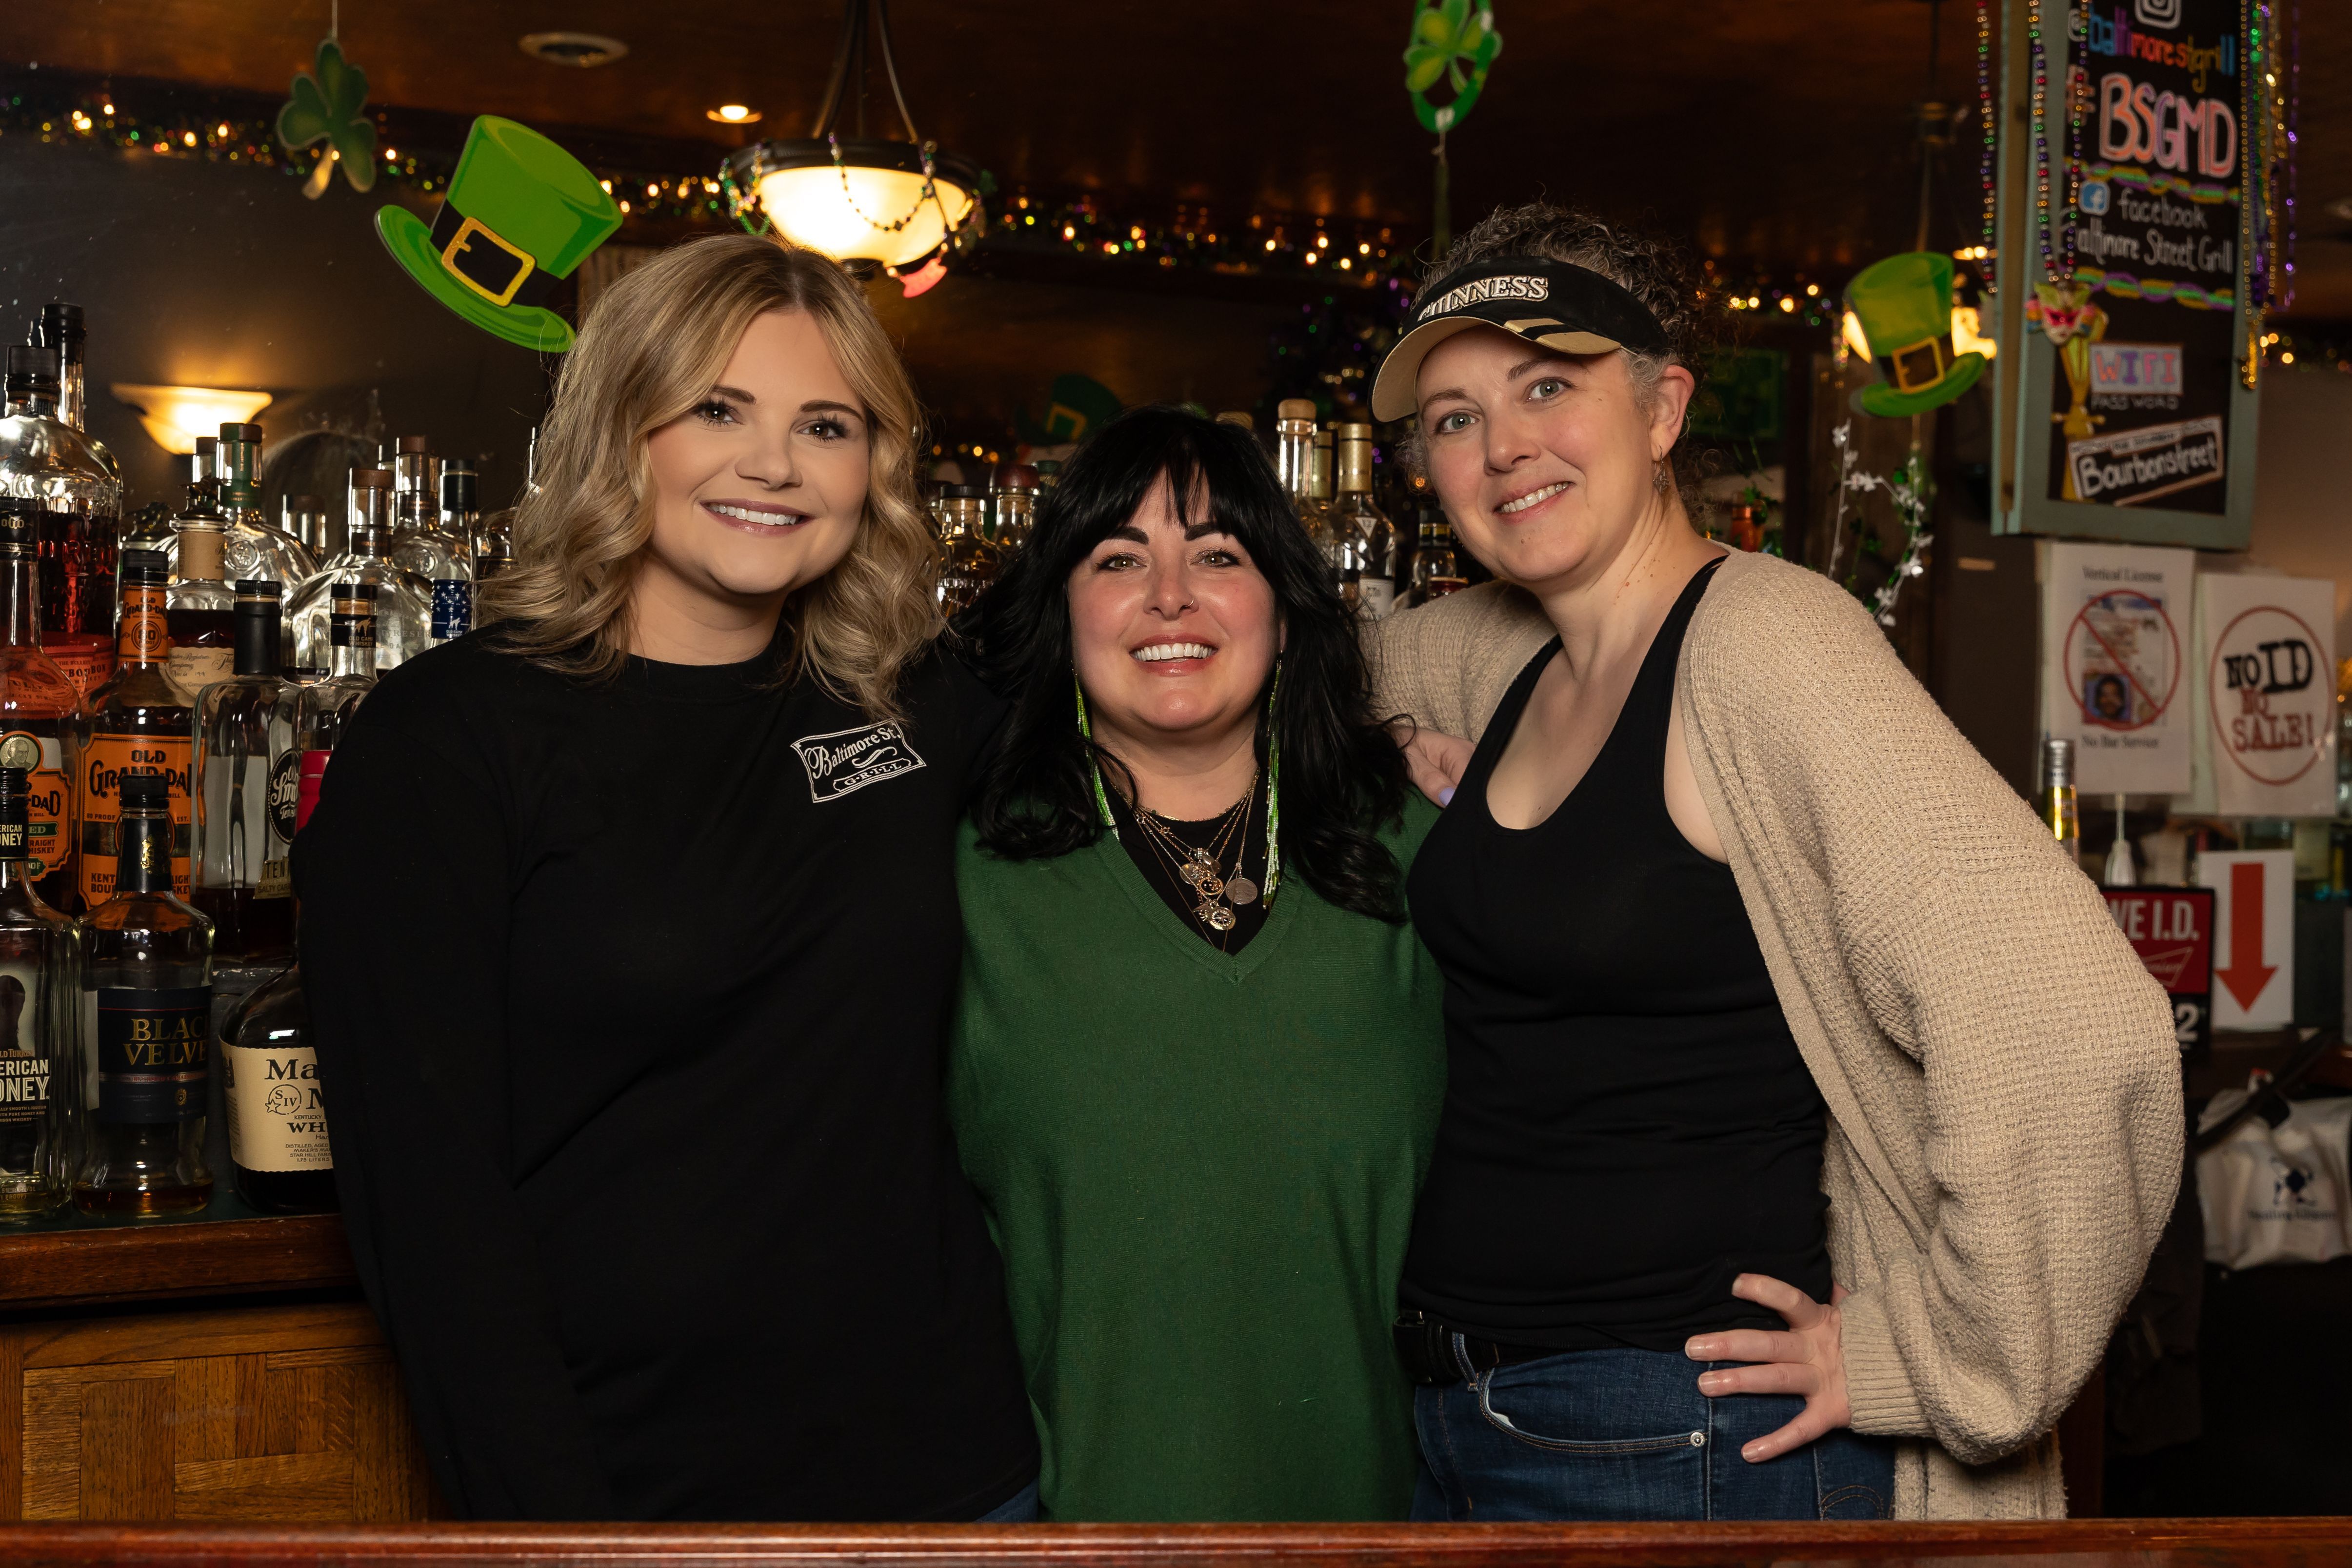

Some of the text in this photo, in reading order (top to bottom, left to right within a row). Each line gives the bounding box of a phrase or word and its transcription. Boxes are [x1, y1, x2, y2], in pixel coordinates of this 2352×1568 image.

[2116, 187, 2209, 230] facebook
[2143, 228, 2198, 272] Street
[2198, 235, 2233, 274] Grill
[2096, 351, 2175, 385] WIFI
[2123, 568, 2163, 582] License
[2224, 639, 2313, 695] NO ID
[2232, 714, 2314, 753] SALE!
[131, 750, 166, 763] OLD
[804, 727, 901, 779] Baltimore St.
[0, 824, 22, 833] RICAN
[0, 833, 22, 846] NEY
[2151, 898, 2201, 942] I.D.
[123, 1040, 210, 1065] VELVE
